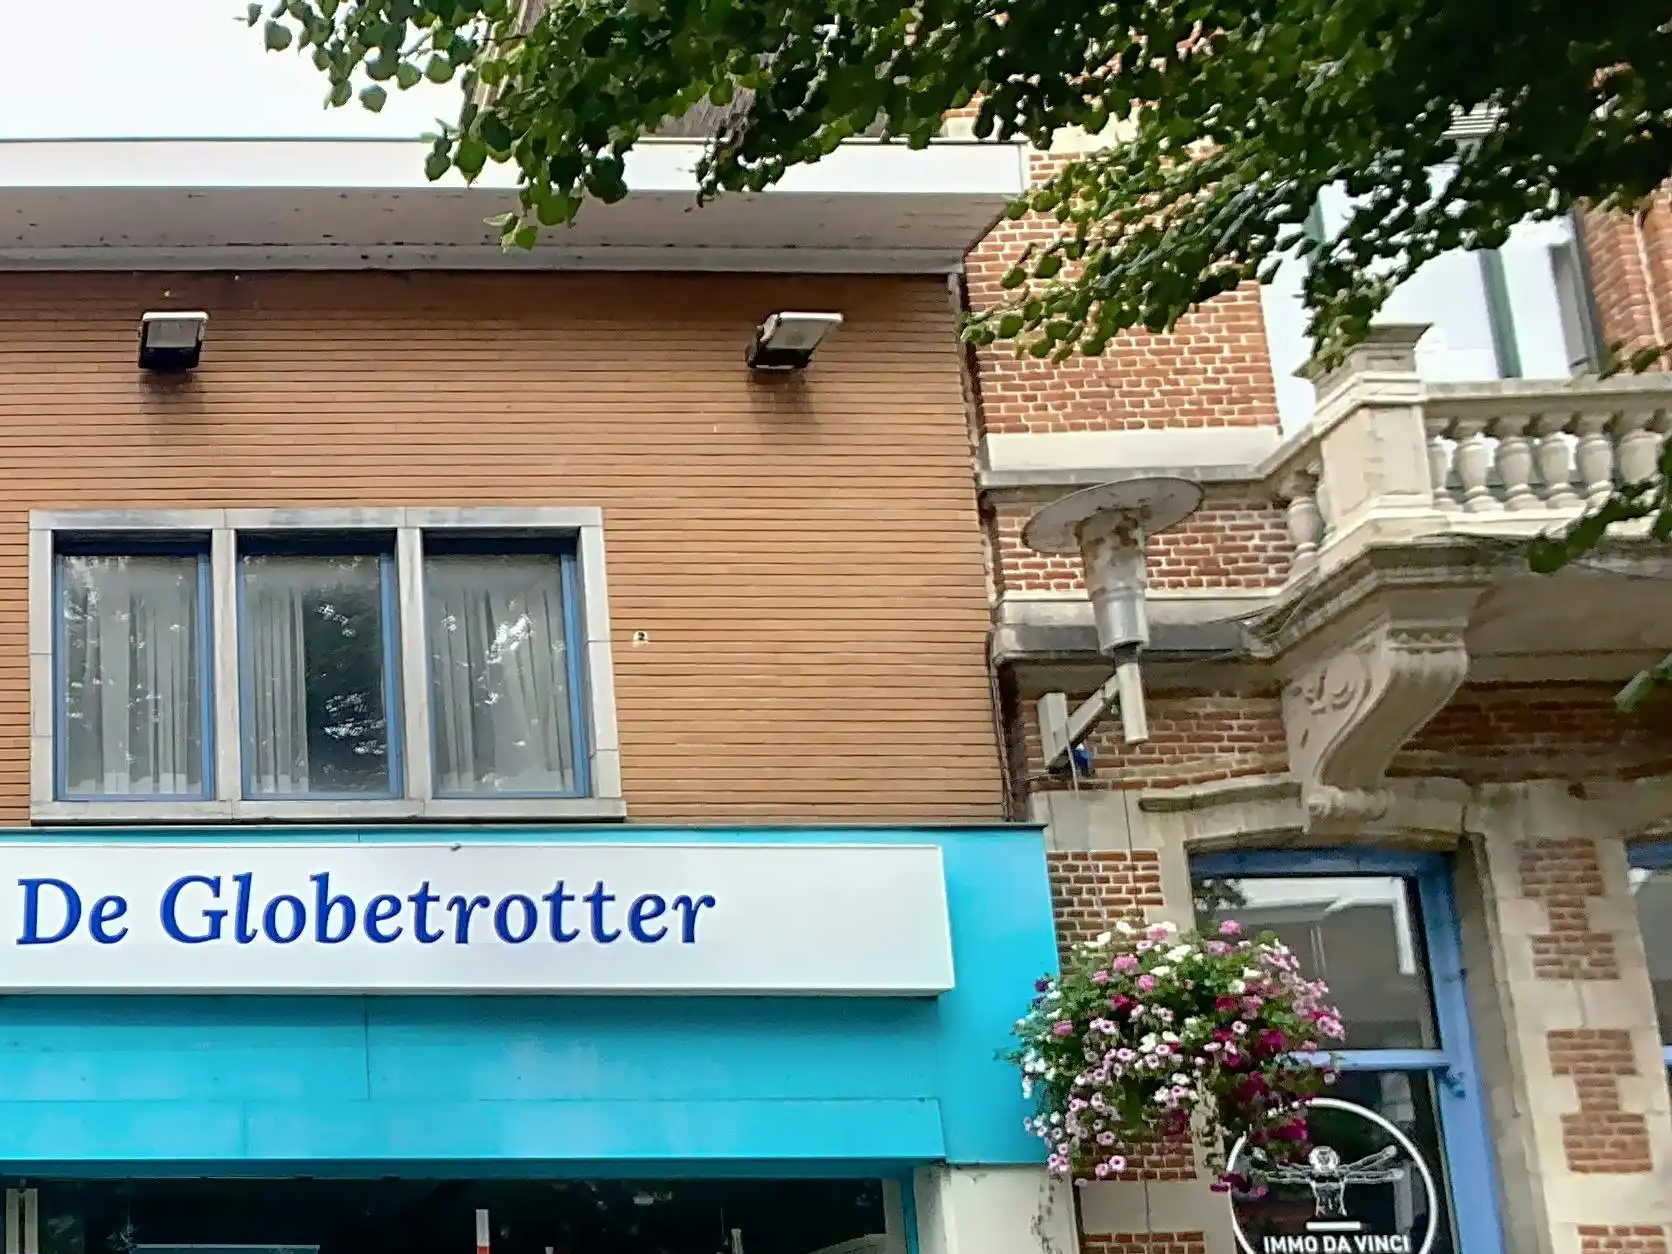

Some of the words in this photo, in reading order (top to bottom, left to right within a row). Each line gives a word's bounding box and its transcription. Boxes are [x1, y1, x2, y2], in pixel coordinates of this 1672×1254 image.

[15, 877, 128, 946] De
[160, 872, 717, 946] Globetrotter
[1264, 1236, 1318, 1254] IMMO
[1324, 1236, 1351, 1254] DA
[1354, 1234, 1411, 1253] VINCI
